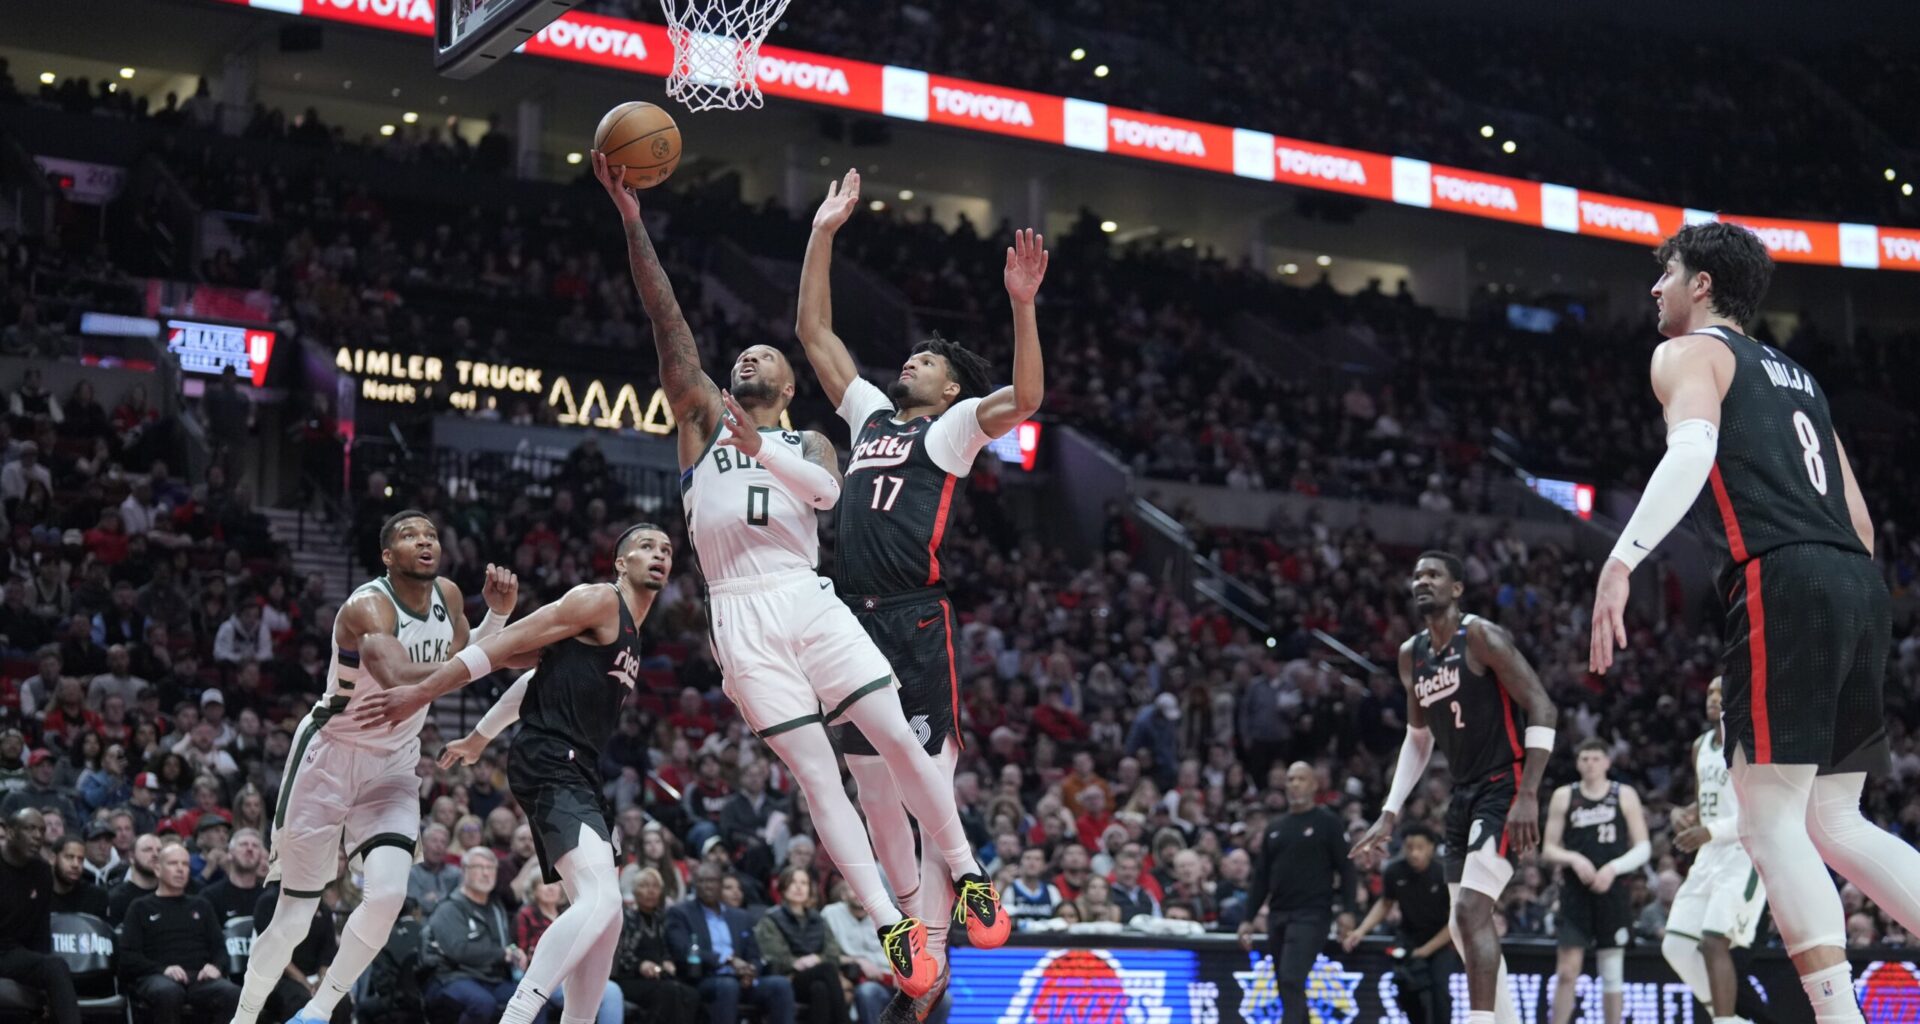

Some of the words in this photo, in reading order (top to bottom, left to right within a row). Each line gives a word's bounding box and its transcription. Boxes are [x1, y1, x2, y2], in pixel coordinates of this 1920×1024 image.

[931, 86, 1034, 127] TOYOTA
[1110, 117, 1206, 157] TOYOTA
[1276, 147, 1366, 185] TOYOTA
[1433, 175, 1518, 211] TOYOTA
[1580, 200, 1660, 236] TOYOTA
[455, 360, 543, 394] TRUCK
[1793, 410, 1827, 496] 8
[747, 486, 769, 526] 0
[871, 475, 904, 511] 17
[408, 638, 452, 663] UCKS
[1414, 665, 1459, 708] ripcity
[1450, 701, 1465, 729] 2
[53, 933, 76, 953] THE
[91, 932, 114, 956] App
